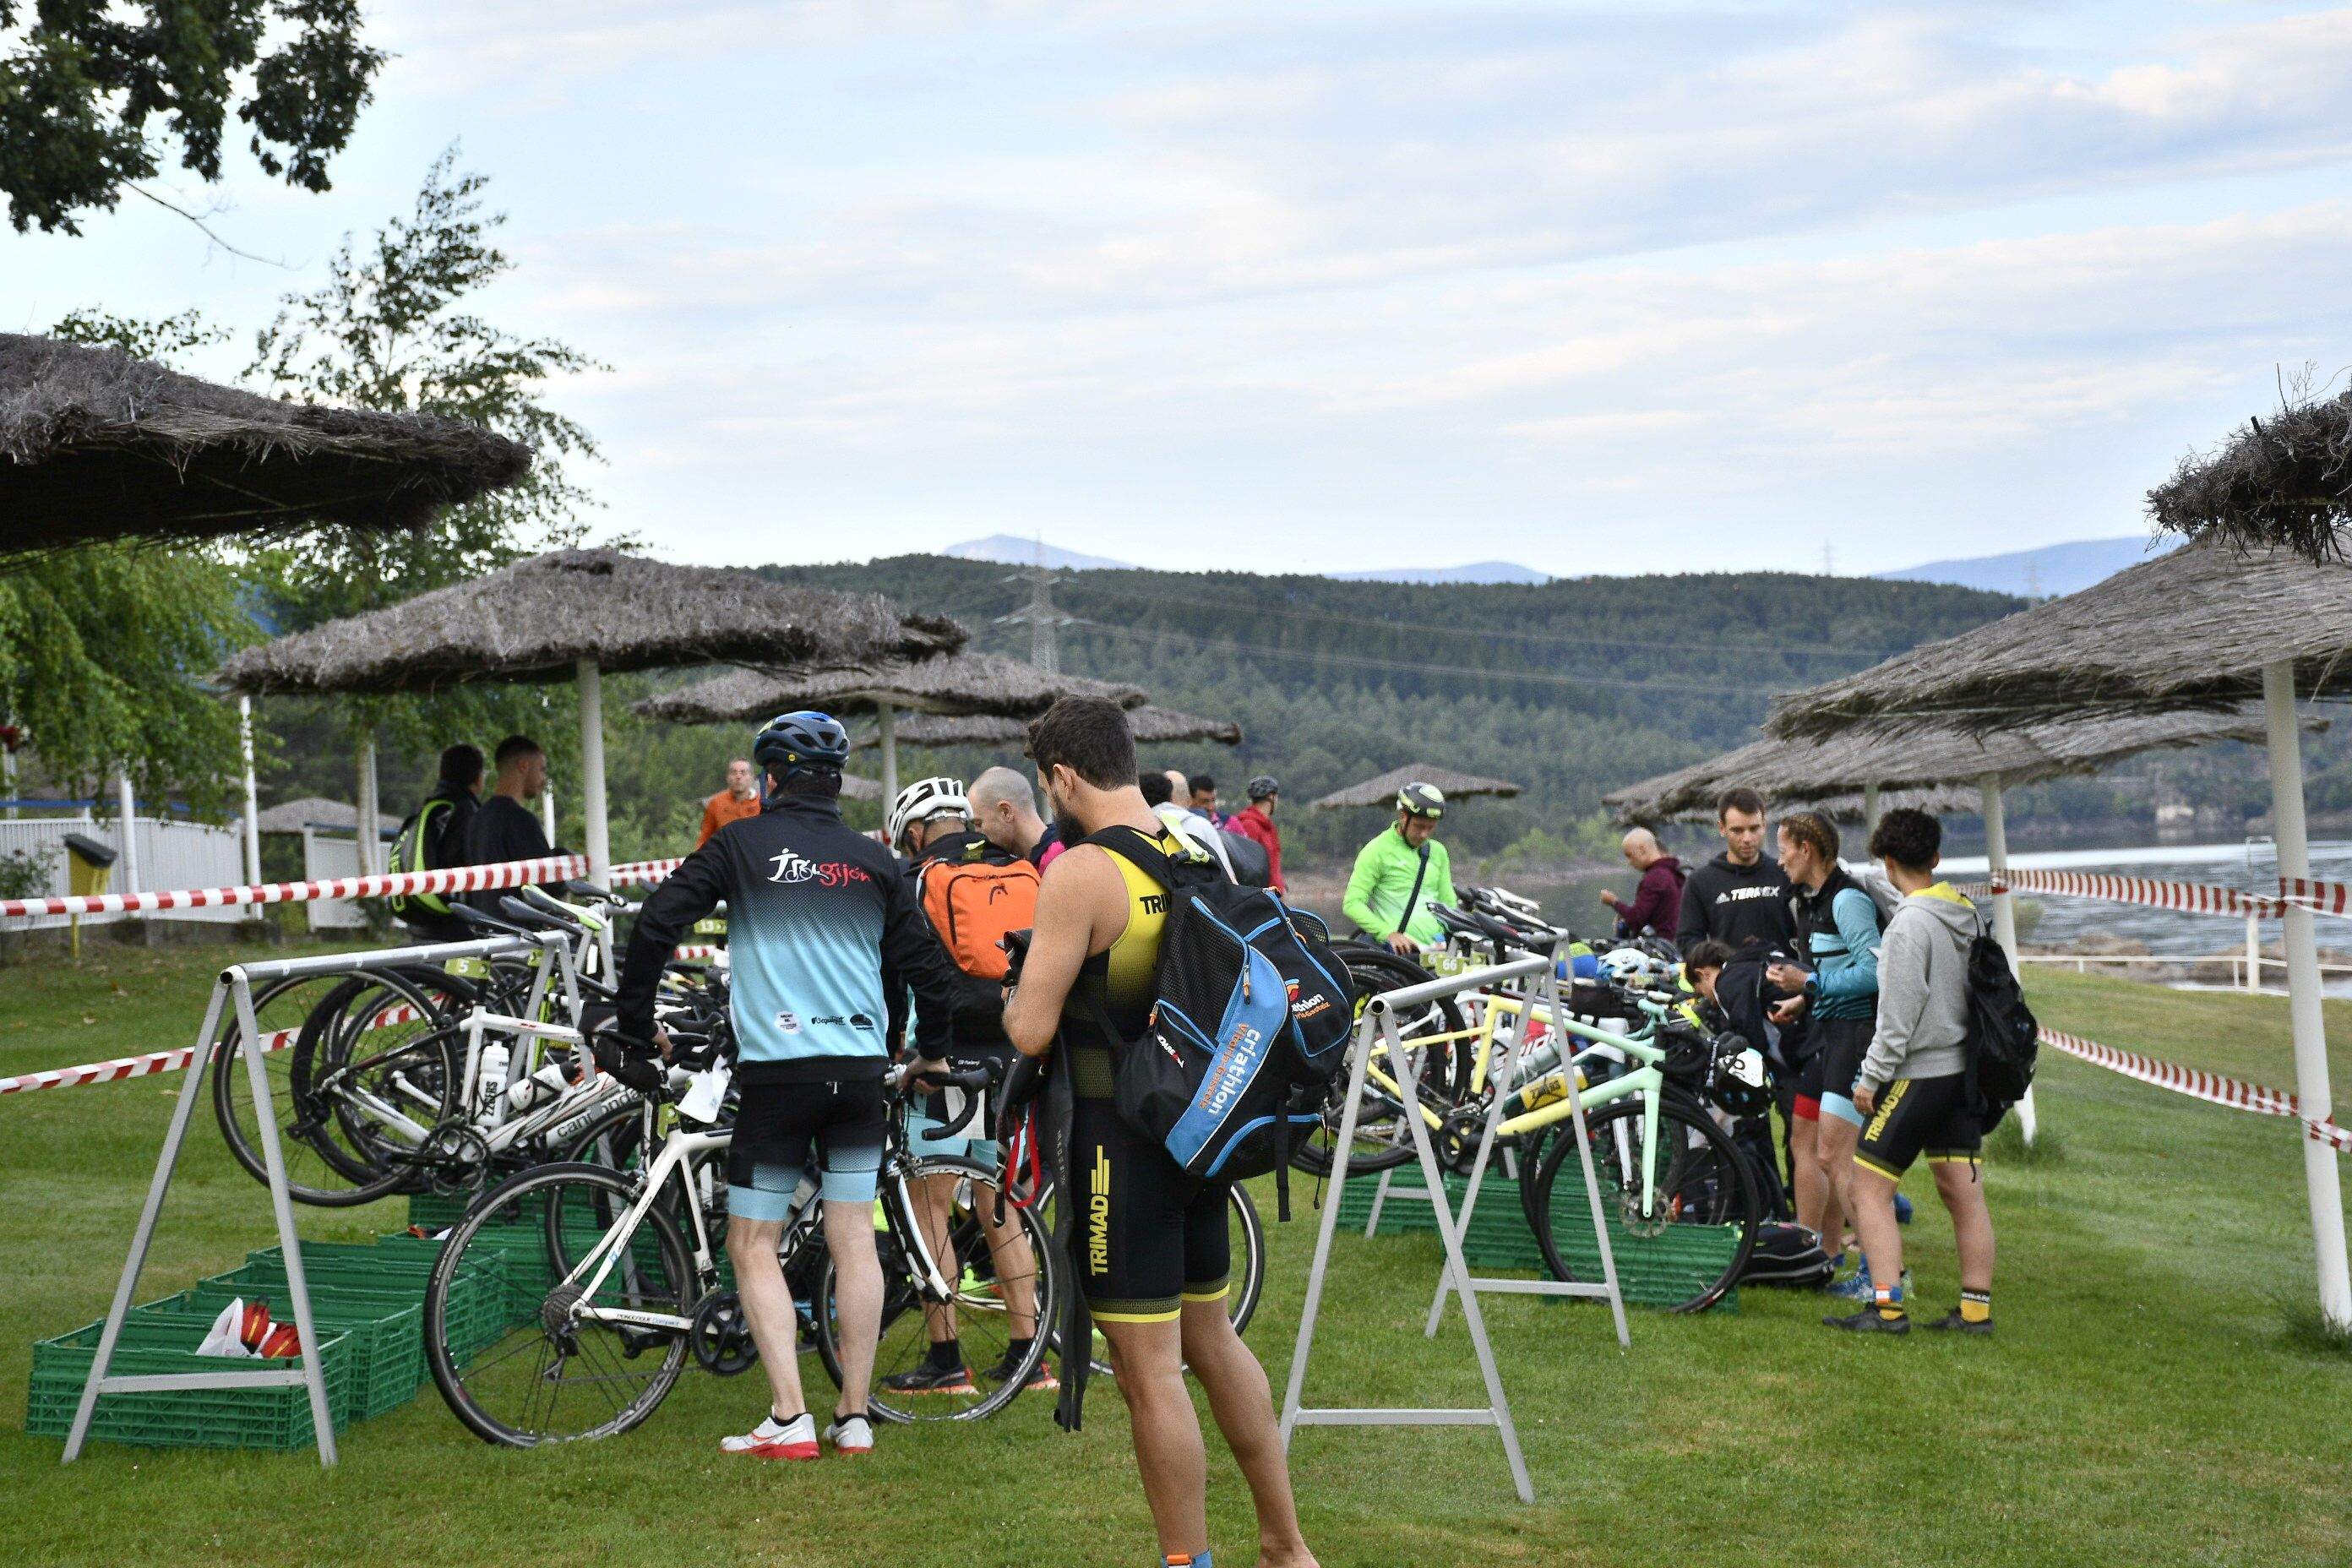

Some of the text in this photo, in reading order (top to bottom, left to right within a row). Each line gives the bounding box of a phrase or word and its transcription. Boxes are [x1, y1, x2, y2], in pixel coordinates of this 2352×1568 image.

[457, 958, 469, 974] 5
[1442, 958, 1457, 971] 66
[1865, 1095, 1899, 1141] TRIMAD
[1089, 1195, 1109, 1277] TRIMAD
